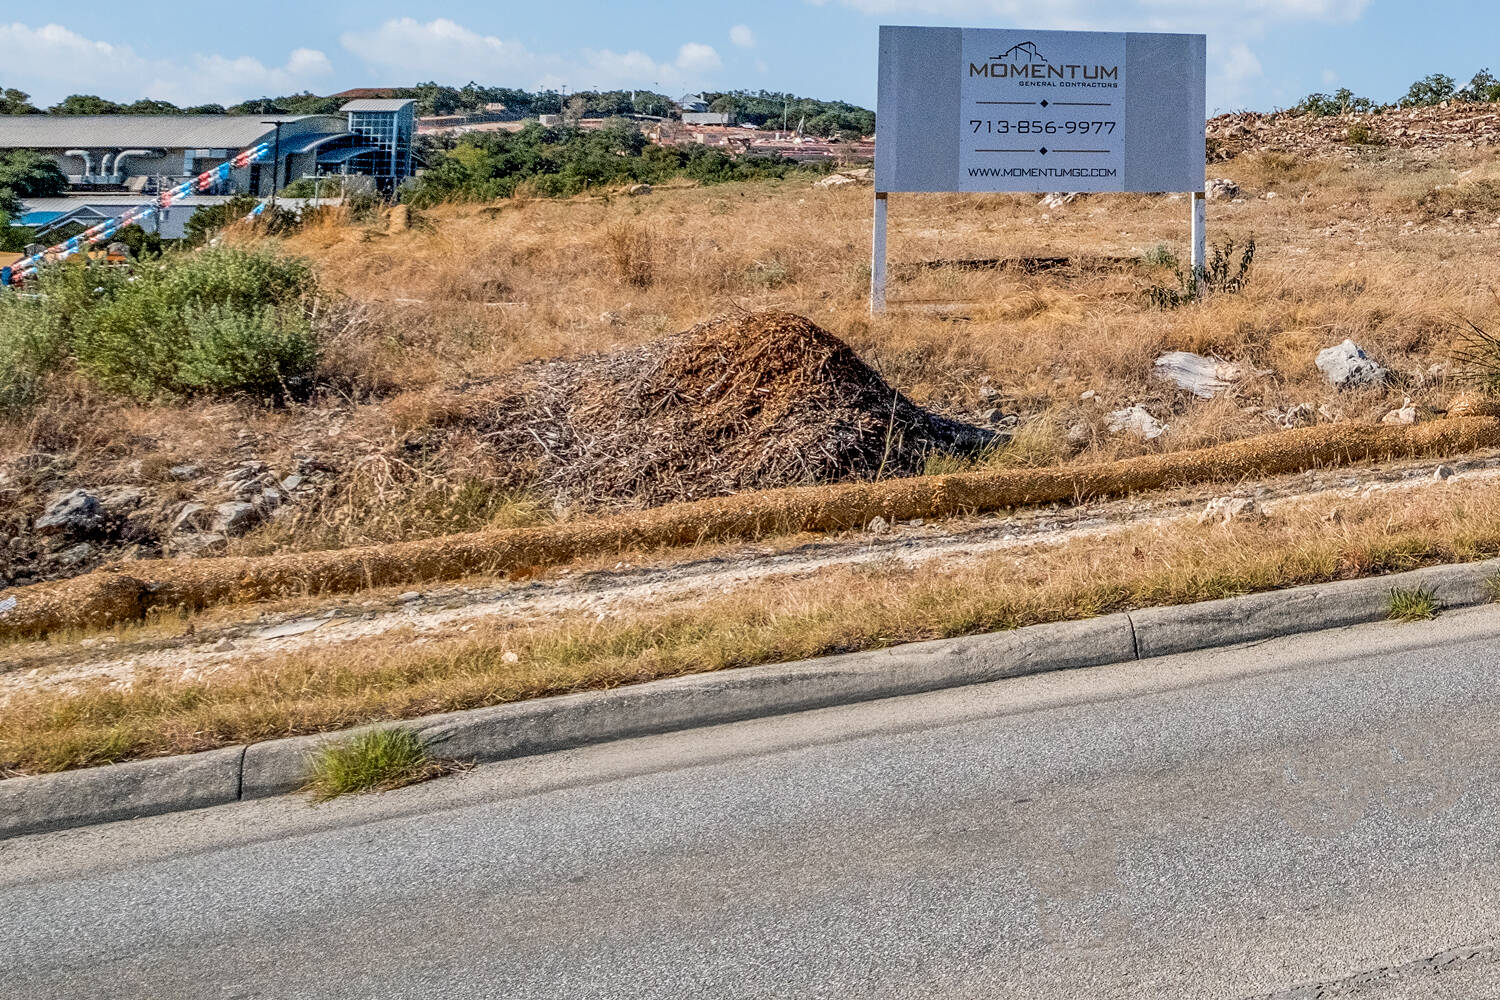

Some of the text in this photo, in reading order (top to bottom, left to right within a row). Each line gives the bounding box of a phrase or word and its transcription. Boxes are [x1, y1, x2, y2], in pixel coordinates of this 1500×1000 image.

[970, 63, 1118, 80] MOMENTUM
[1019, 80, 1118, 89] GENERAL CONTRACTORS
[970, 120, 1116, 134] 713-856-9977
[968, 168, 1116, 178] WWW.MOMENTUMGC.COM
